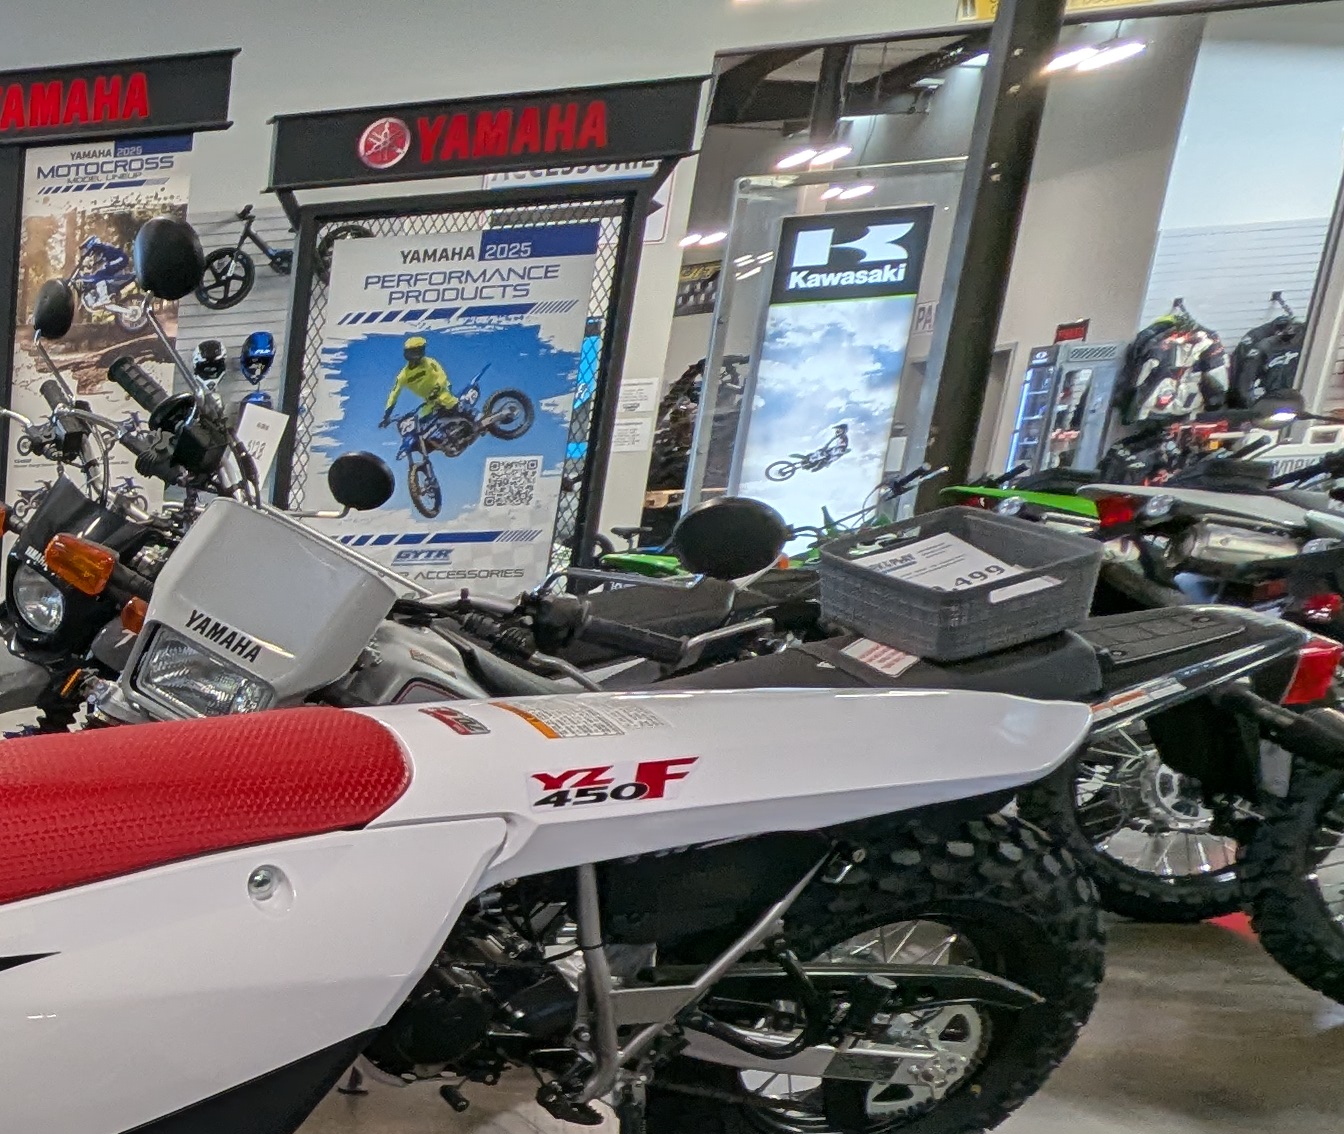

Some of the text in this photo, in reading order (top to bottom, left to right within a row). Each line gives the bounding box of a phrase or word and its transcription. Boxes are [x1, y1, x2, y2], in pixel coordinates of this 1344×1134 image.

[417, 100, 607, 162] YAMAHA
[70, 148, 112, 161] YAMAHA
[36, 156, 174, 180] MOTOCROSS
[400, 242, 533, 264] YAMAHA 2025
[364, 264, 561, 291] PERFORMANCE
[788, 261, 906, 290] Kawasaki
[387, 283, 530, 306] PRODUCTS
[414, 568, 525, 580] ACCESSORIES
[184, 609, 263, 664] YAMAHA
[531, 766, 616, 791] YZ
[533, 782, 650, 808] 450
